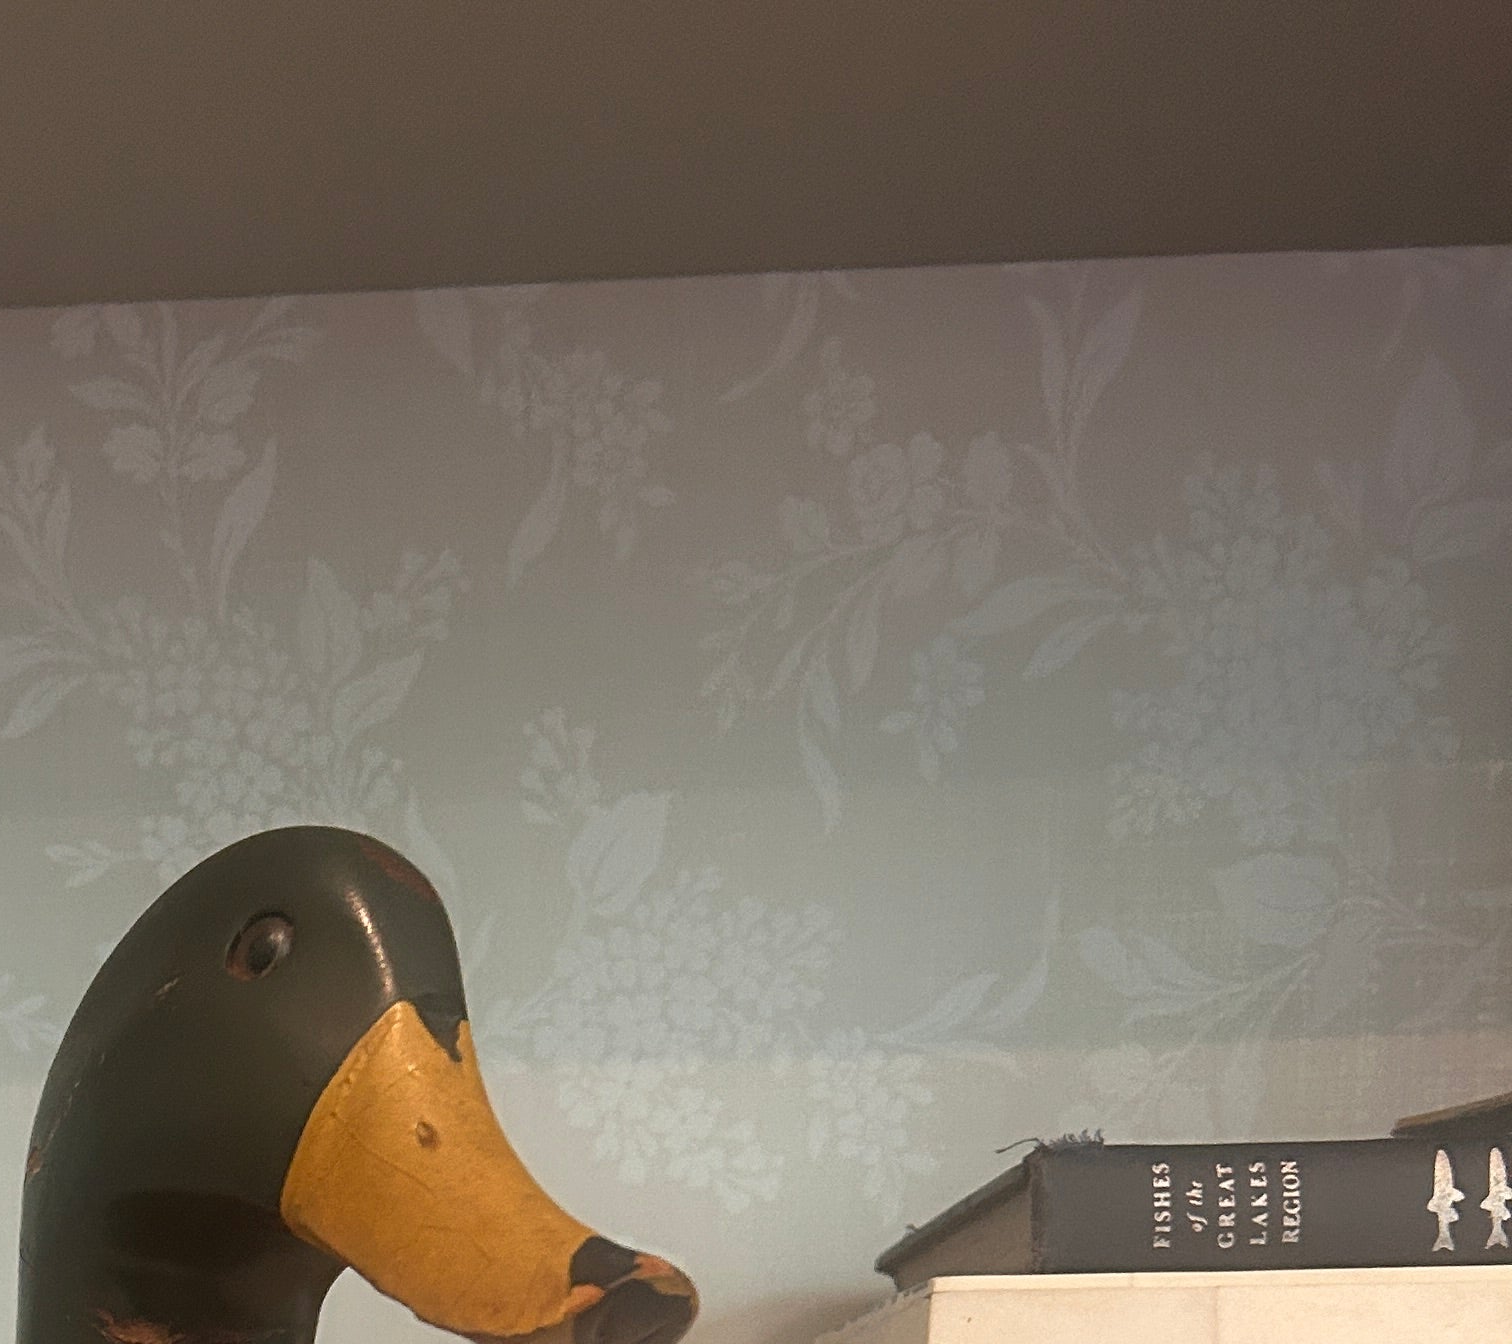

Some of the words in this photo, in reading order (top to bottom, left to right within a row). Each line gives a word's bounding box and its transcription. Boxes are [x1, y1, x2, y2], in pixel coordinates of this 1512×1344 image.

[1151, 1162, 1171, 1248] FISHES
[1185, 1180, 1204, 1206] the
[1186, 1212, 1208, 1233] of
[1215, 1163, 1236, 1249] GREAT
[1248, 1161, 1269, 1246] LAKES
[1280, 1160, 1301, 1243] REGION
